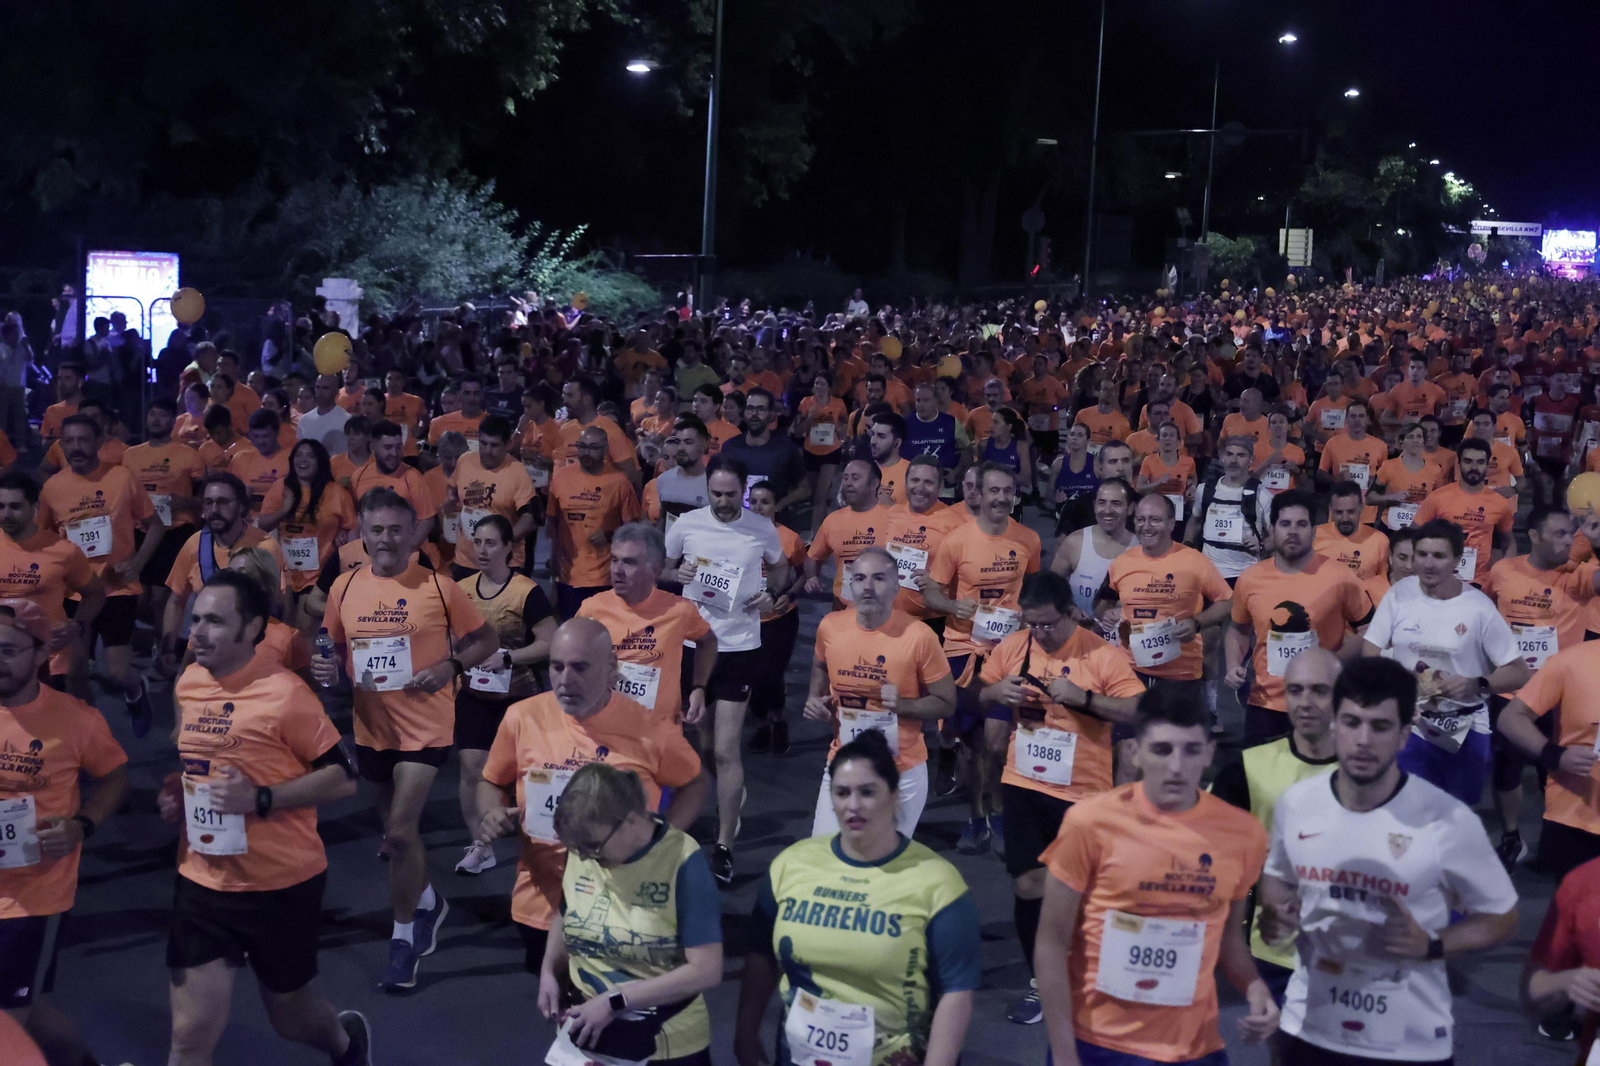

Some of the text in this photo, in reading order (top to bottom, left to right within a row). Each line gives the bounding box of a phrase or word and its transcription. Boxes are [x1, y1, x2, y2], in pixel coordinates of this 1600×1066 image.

[1215, 519, 1232, 528] 2831
[80, 530, 100, 543] 7391
[699, 572, 730, 590] 10365
[612, 643, 637, 651] EVILLA
[1140, 634, 1171, 650] 12395
[1517, 640, 1549, 652] 12676
[1277, 646, 1310, 659] 195
[367, 656, 396, 670] 4774
[837, 669, 869, 679] SEVILLA
[184, 723, 212, 733] SEVILLA
[198, 716, 233, 726] NOCTURNA
[1026, 743, 1062, 762] 13888
[1164, 872, 1217, 884] NOCTURNA
[1296, 864, 1410, 897] MARATHON
[813, 886, 869, 902] RUNNERS
[1138, 881, 1186, 893] SEVILLA
[1329, 884, 1368, 901] BET
[781, 896, 903, 938] BARREÑOS
[1129, 945, 1178, 970] 9889
[1329, 985, 1388, 1015] 14005
[806, 1024, 849, 1053] 7205
